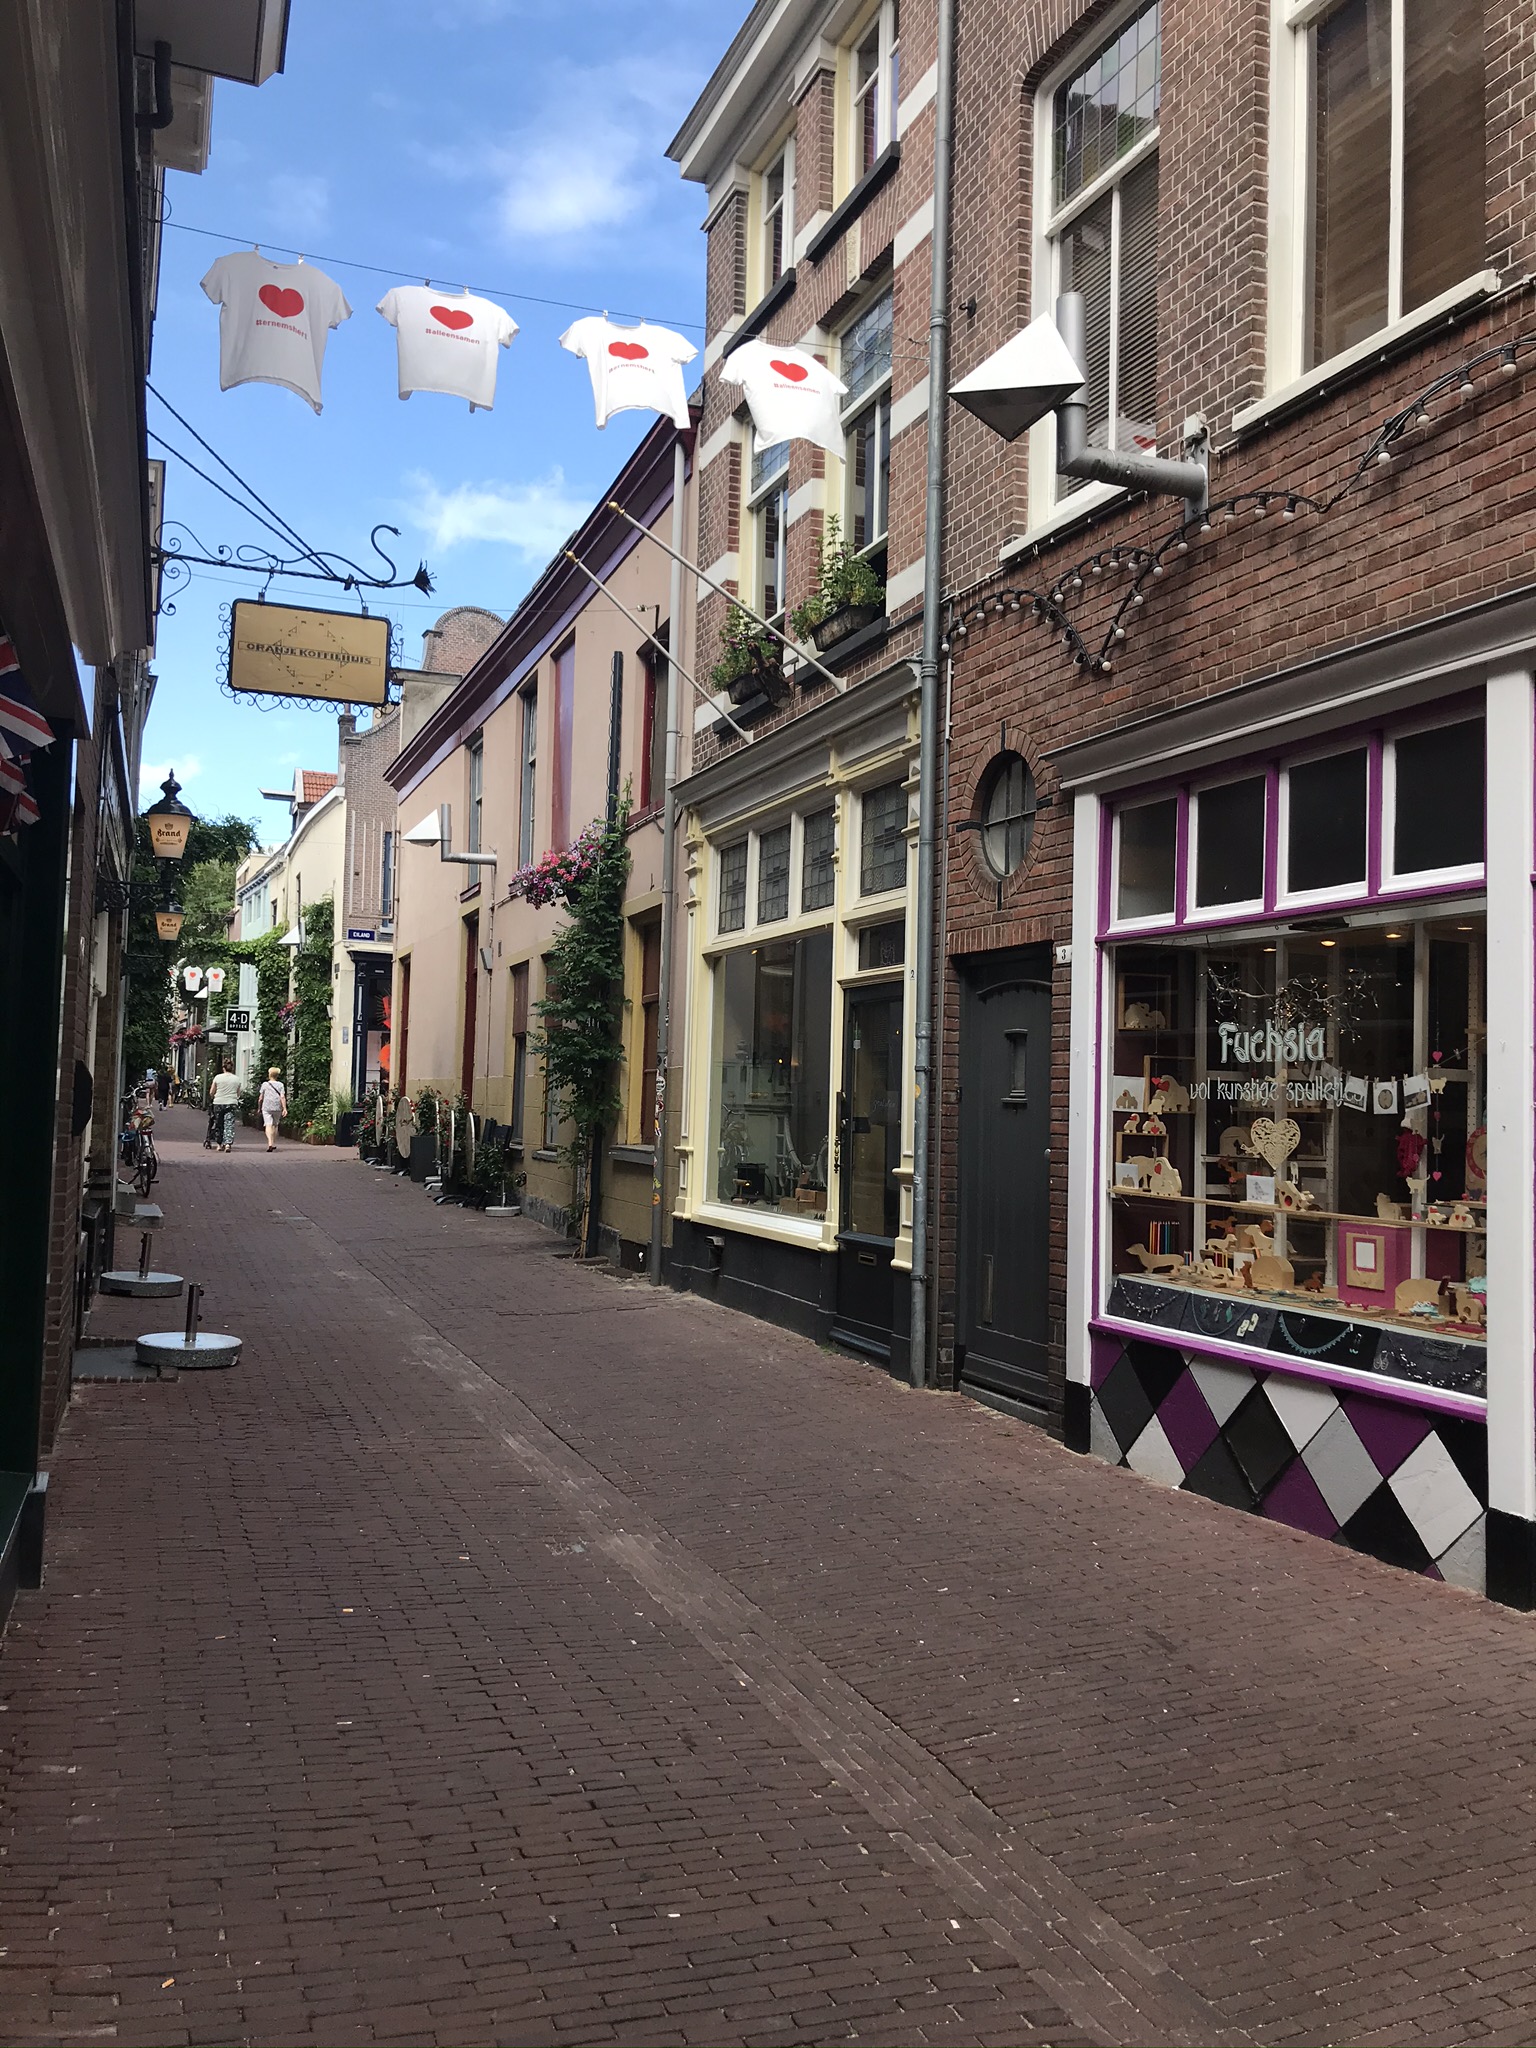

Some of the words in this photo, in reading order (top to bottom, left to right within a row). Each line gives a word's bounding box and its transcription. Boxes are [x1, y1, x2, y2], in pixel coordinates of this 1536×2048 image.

[157, 828, 181, 837] Brand
[1061, 948, 1067, 961] 3
[1218, 1018, 1326, 1064] Fuchsia
[1189, 1077, 1211, 1100] vol
[1217, 1076, 1280, 1106] kunstige
